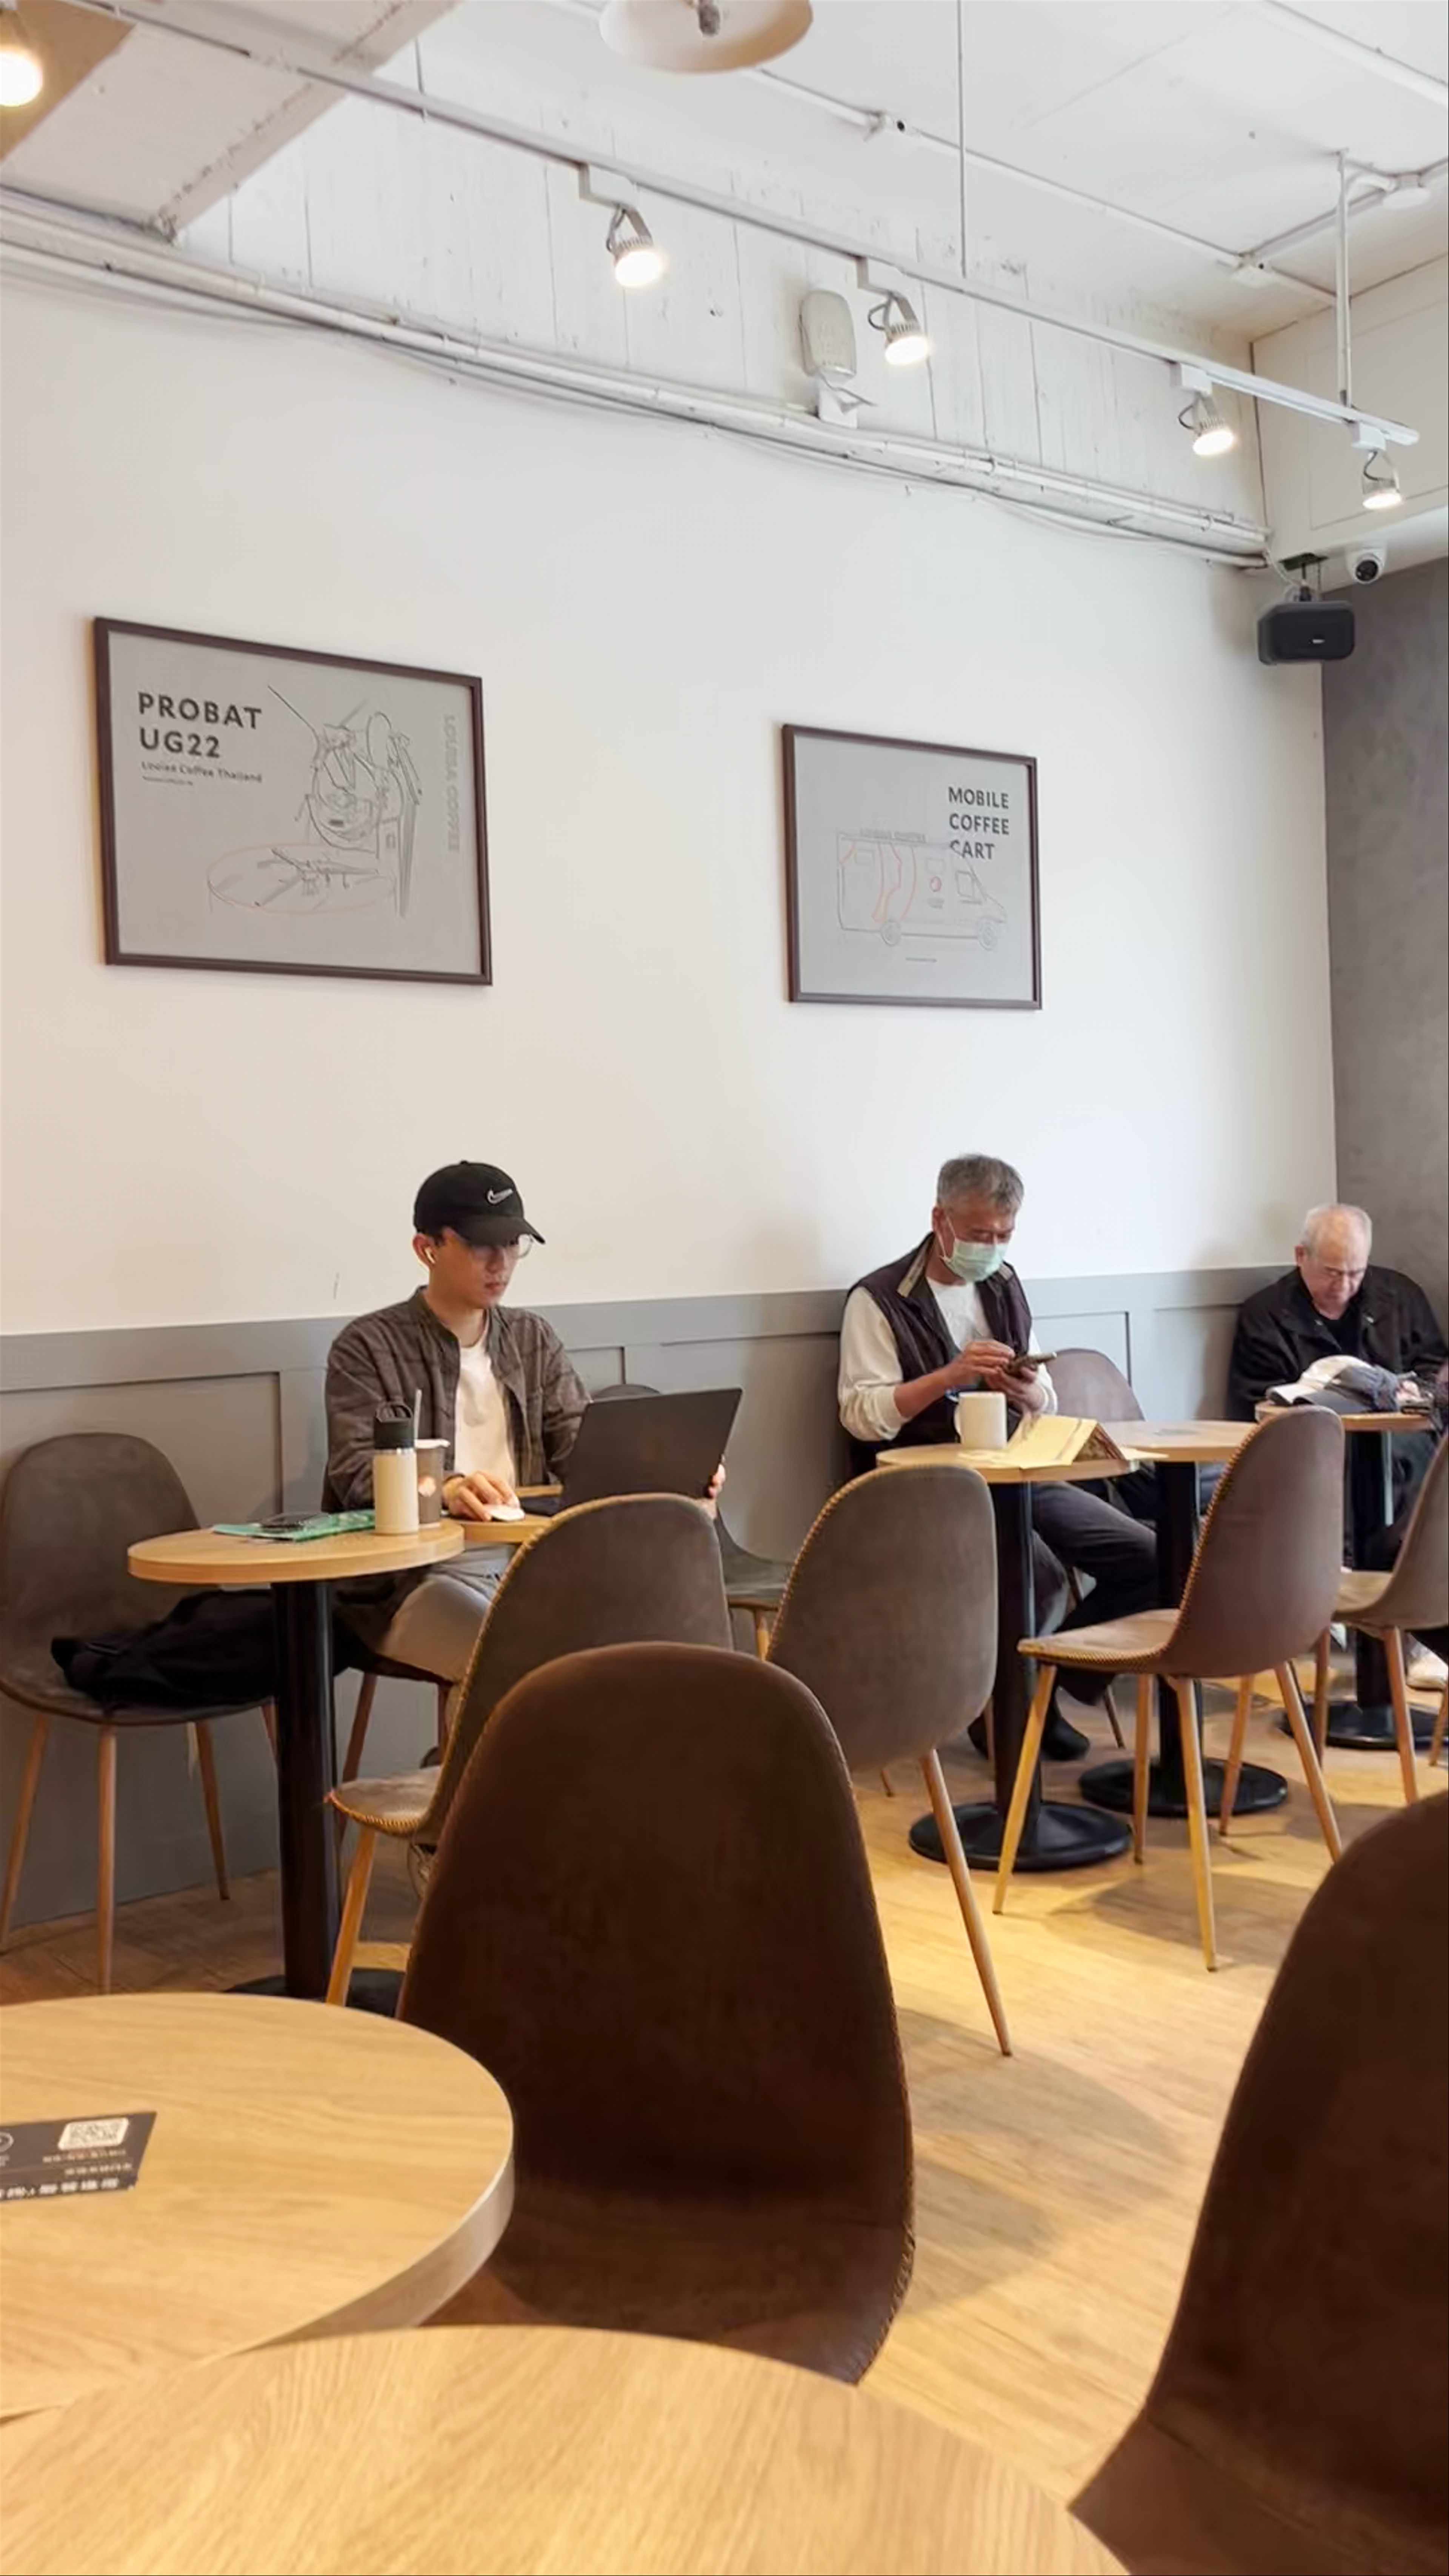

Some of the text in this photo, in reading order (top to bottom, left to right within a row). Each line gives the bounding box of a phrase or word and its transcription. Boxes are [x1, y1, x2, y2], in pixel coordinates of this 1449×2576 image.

[138, 692, 261, 729] PROBAT
[140, 727, 220, 758] UG22
[948, 787, 1009, 809] MOBILE
[949, 813, 1009, 835] COFFEE
[950, 840, 995, 860] CART
